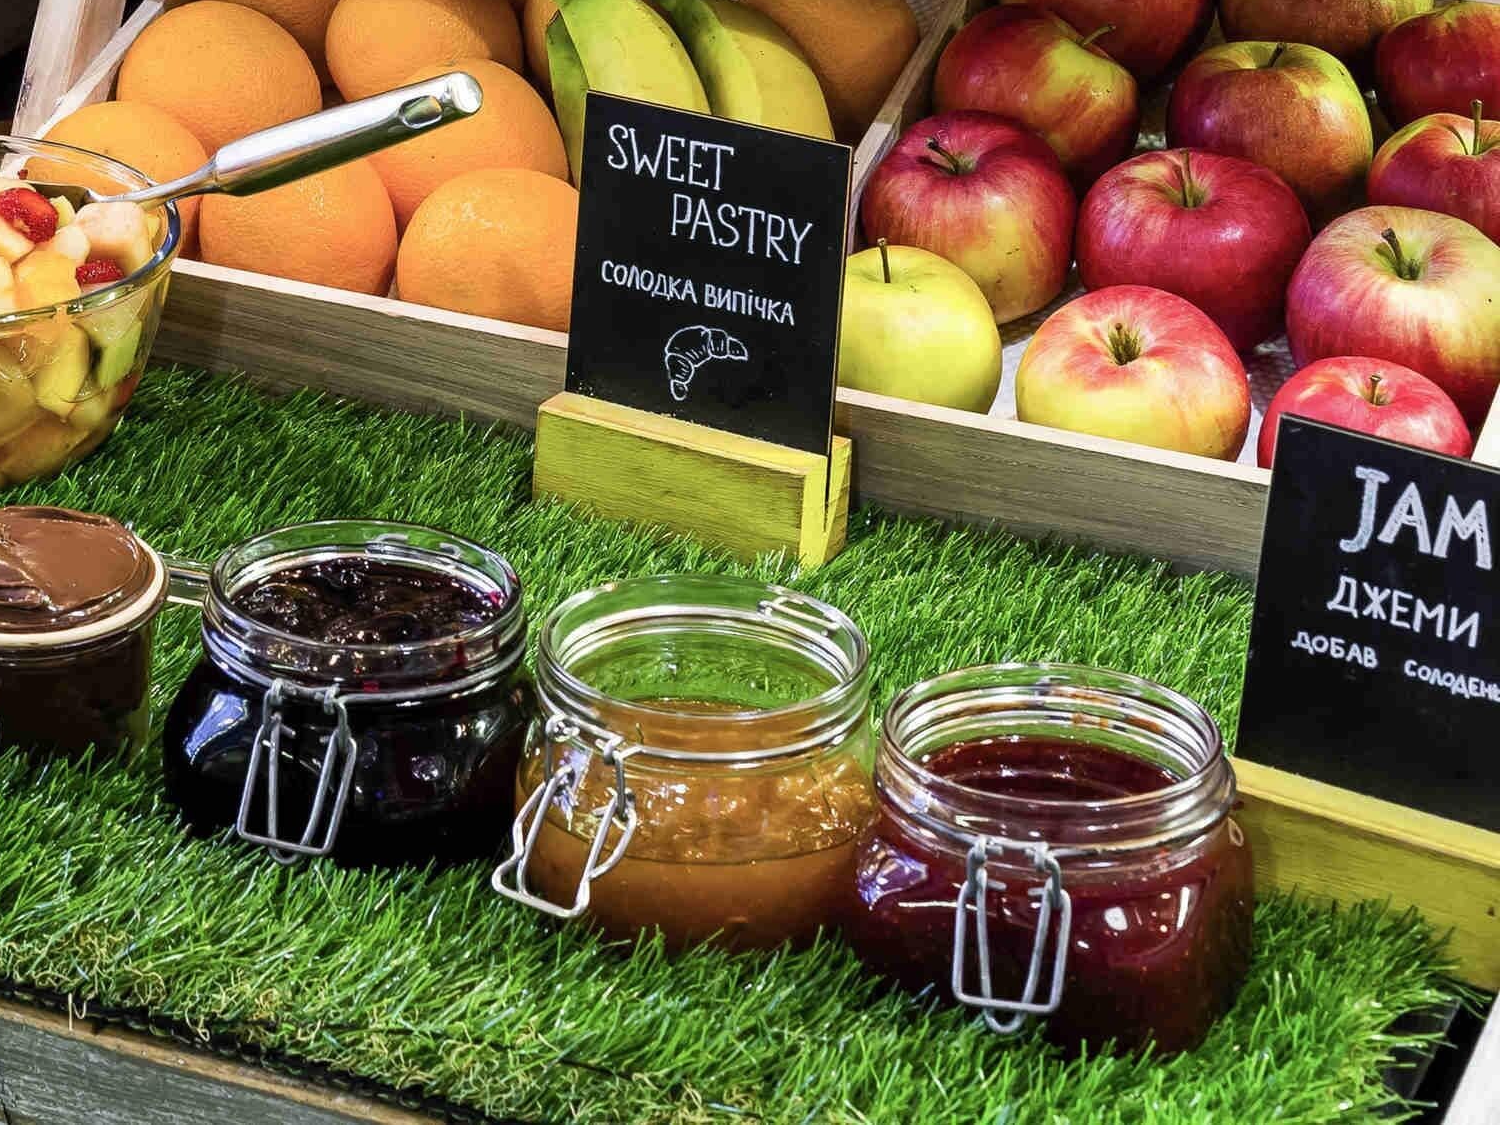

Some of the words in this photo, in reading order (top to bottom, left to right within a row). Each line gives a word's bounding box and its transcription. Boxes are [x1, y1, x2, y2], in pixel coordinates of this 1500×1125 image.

[607, 124, 734, 190] SWEET
[670, 193, 813, 264] PASTRY
[601, 260, 698, 304] СОЛОДКА
[705, 283, 795, 326] ВИПІЧКА
[1339, 465, 1493, 570] JAM
[1326, 576, 1481, 648] ДЖЕМИ
[1290, 631, 1379, 669] ДОБАВ
